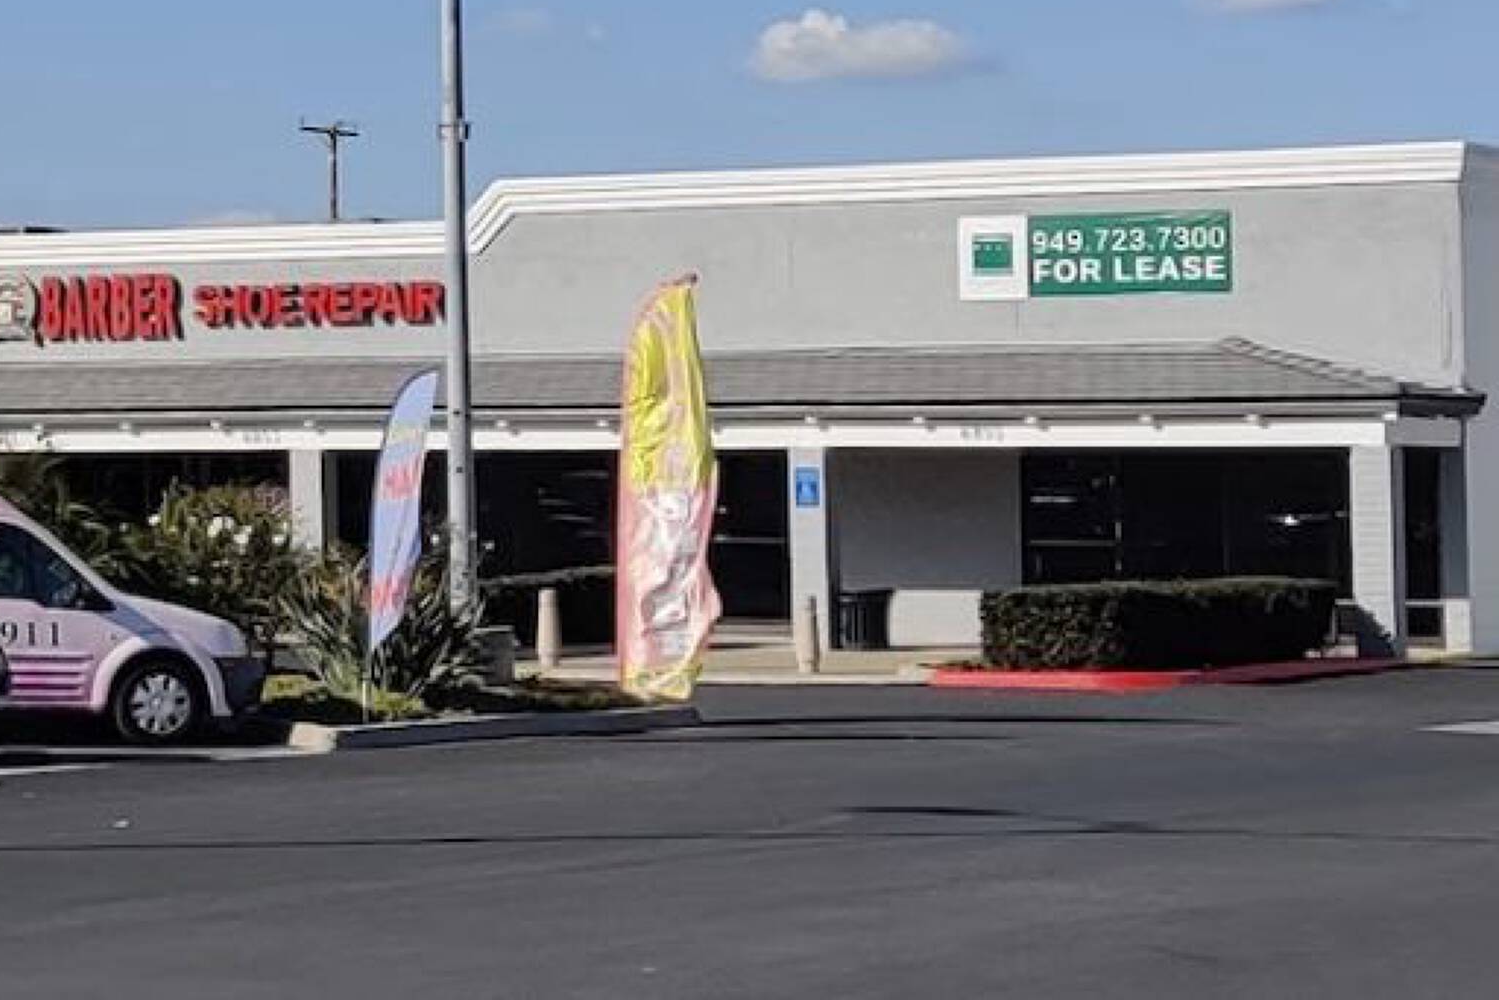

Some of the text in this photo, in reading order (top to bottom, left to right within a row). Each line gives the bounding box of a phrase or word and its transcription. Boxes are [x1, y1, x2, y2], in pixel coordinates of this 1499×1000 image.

[1031, 226, 1226, 254] 949.723.7300
[1032, 255, 1227, 284] FOR LEASE
[41, 274, 182, 341] BARBER
